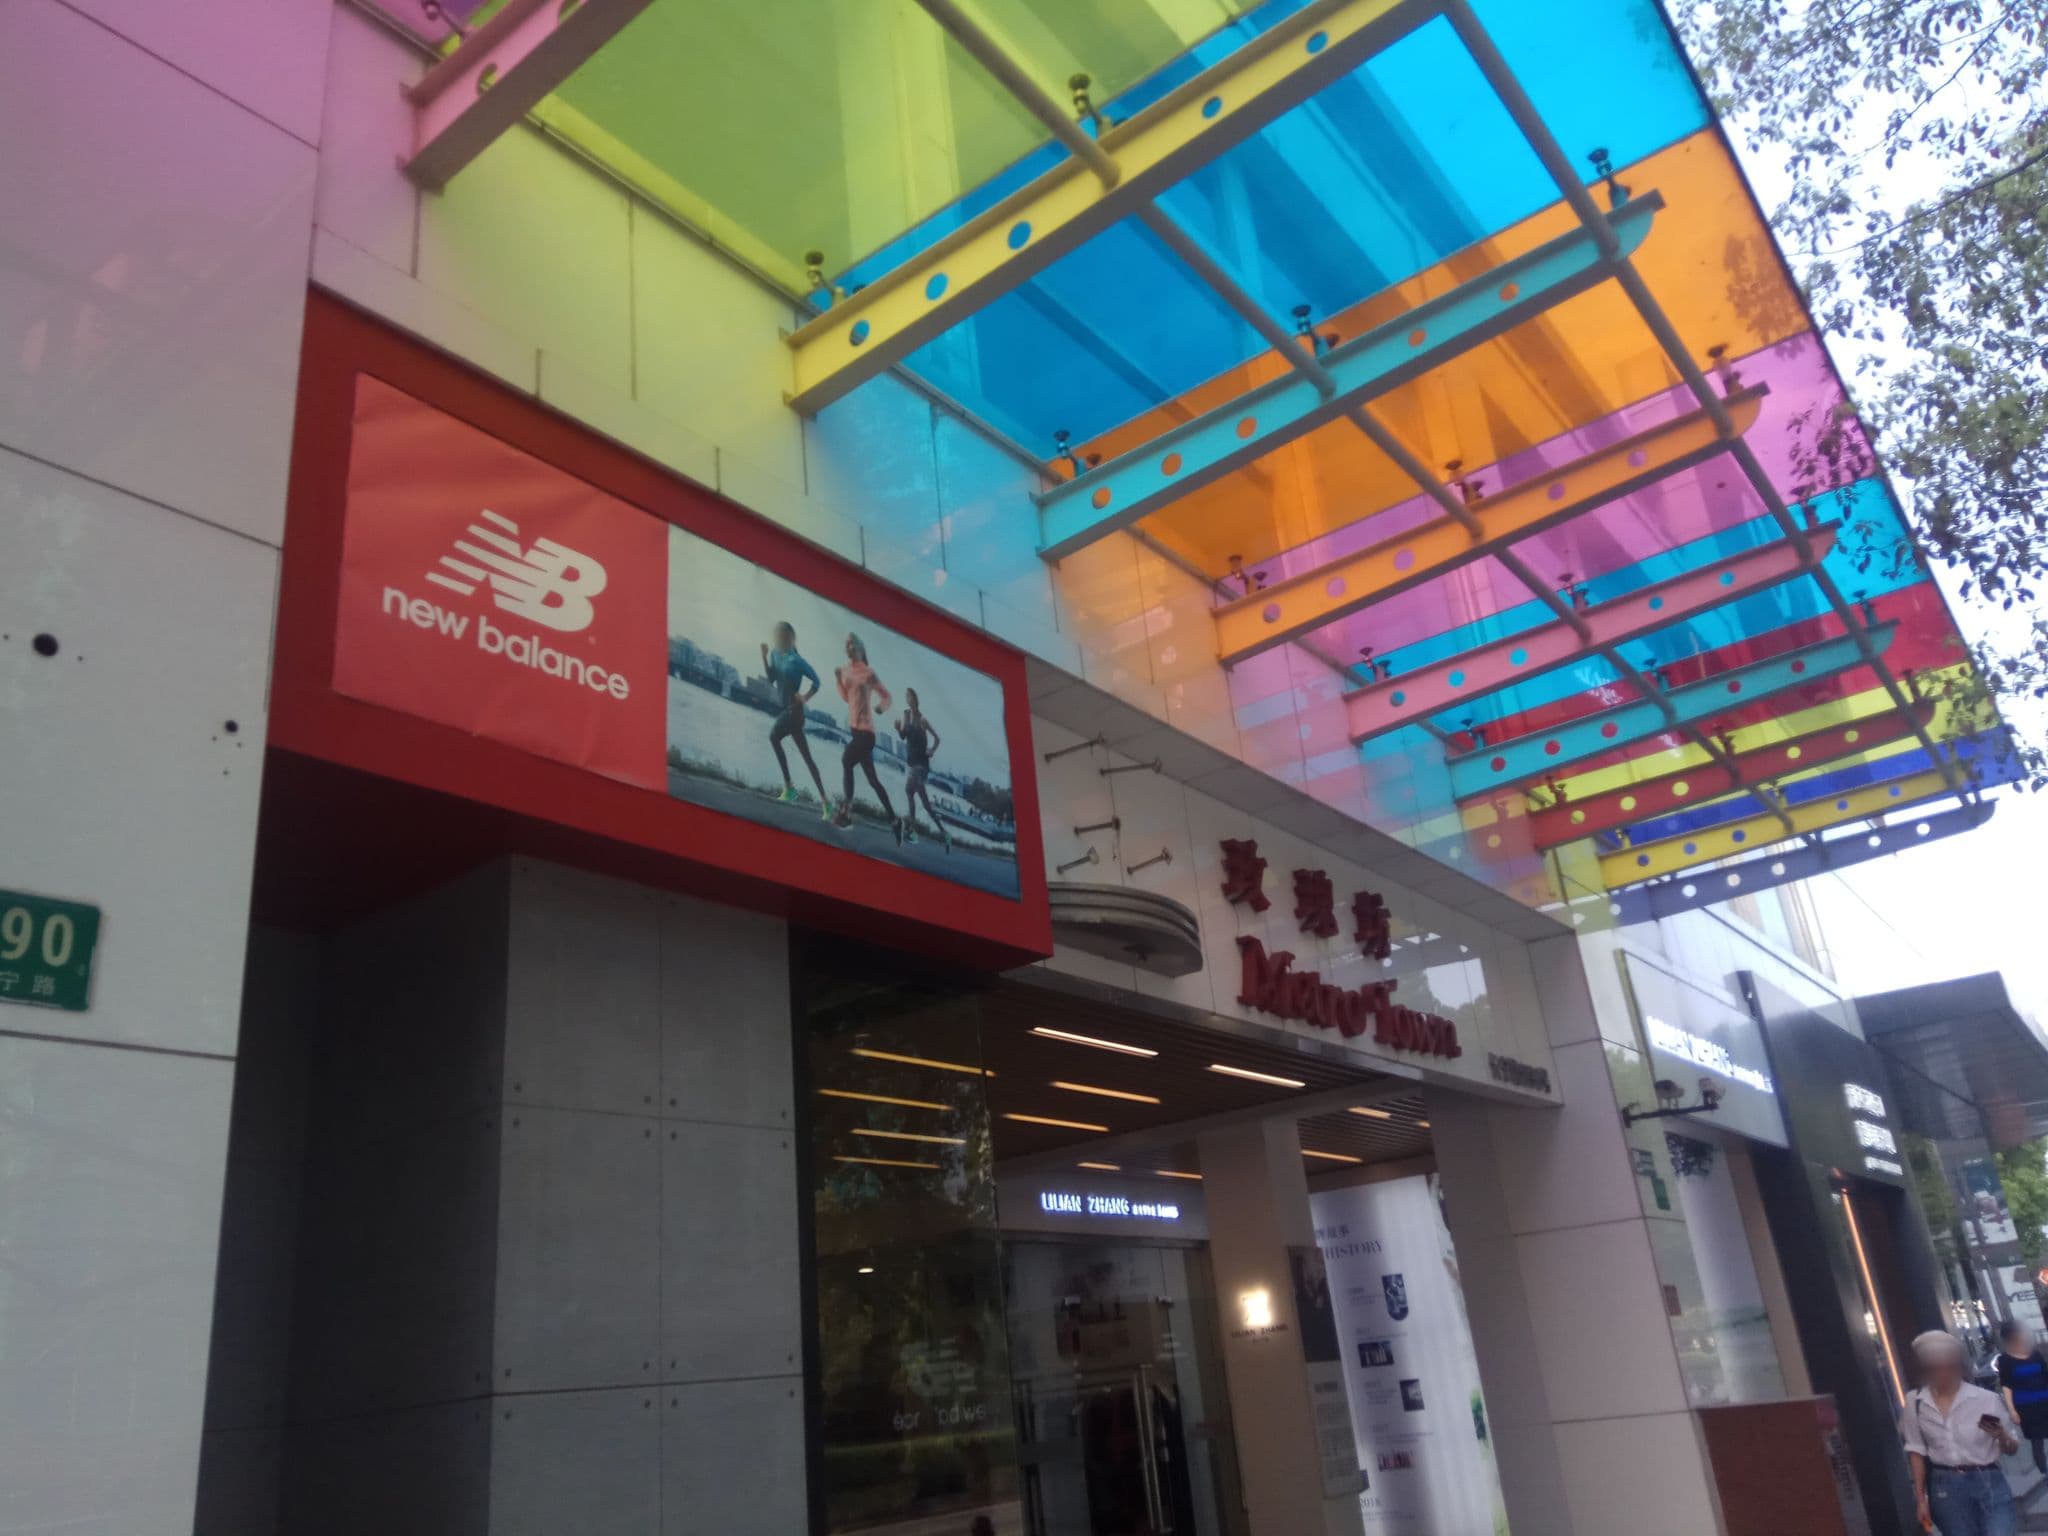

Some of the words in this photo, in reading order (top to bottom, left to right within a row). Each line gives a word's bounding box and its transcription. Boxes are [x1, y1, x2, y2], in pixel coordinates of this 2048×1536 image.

[382, 586, 469, 640] new
[478, 615, 630, 700] balance
[1087, 1195, 1130, 1216] ZHANG
